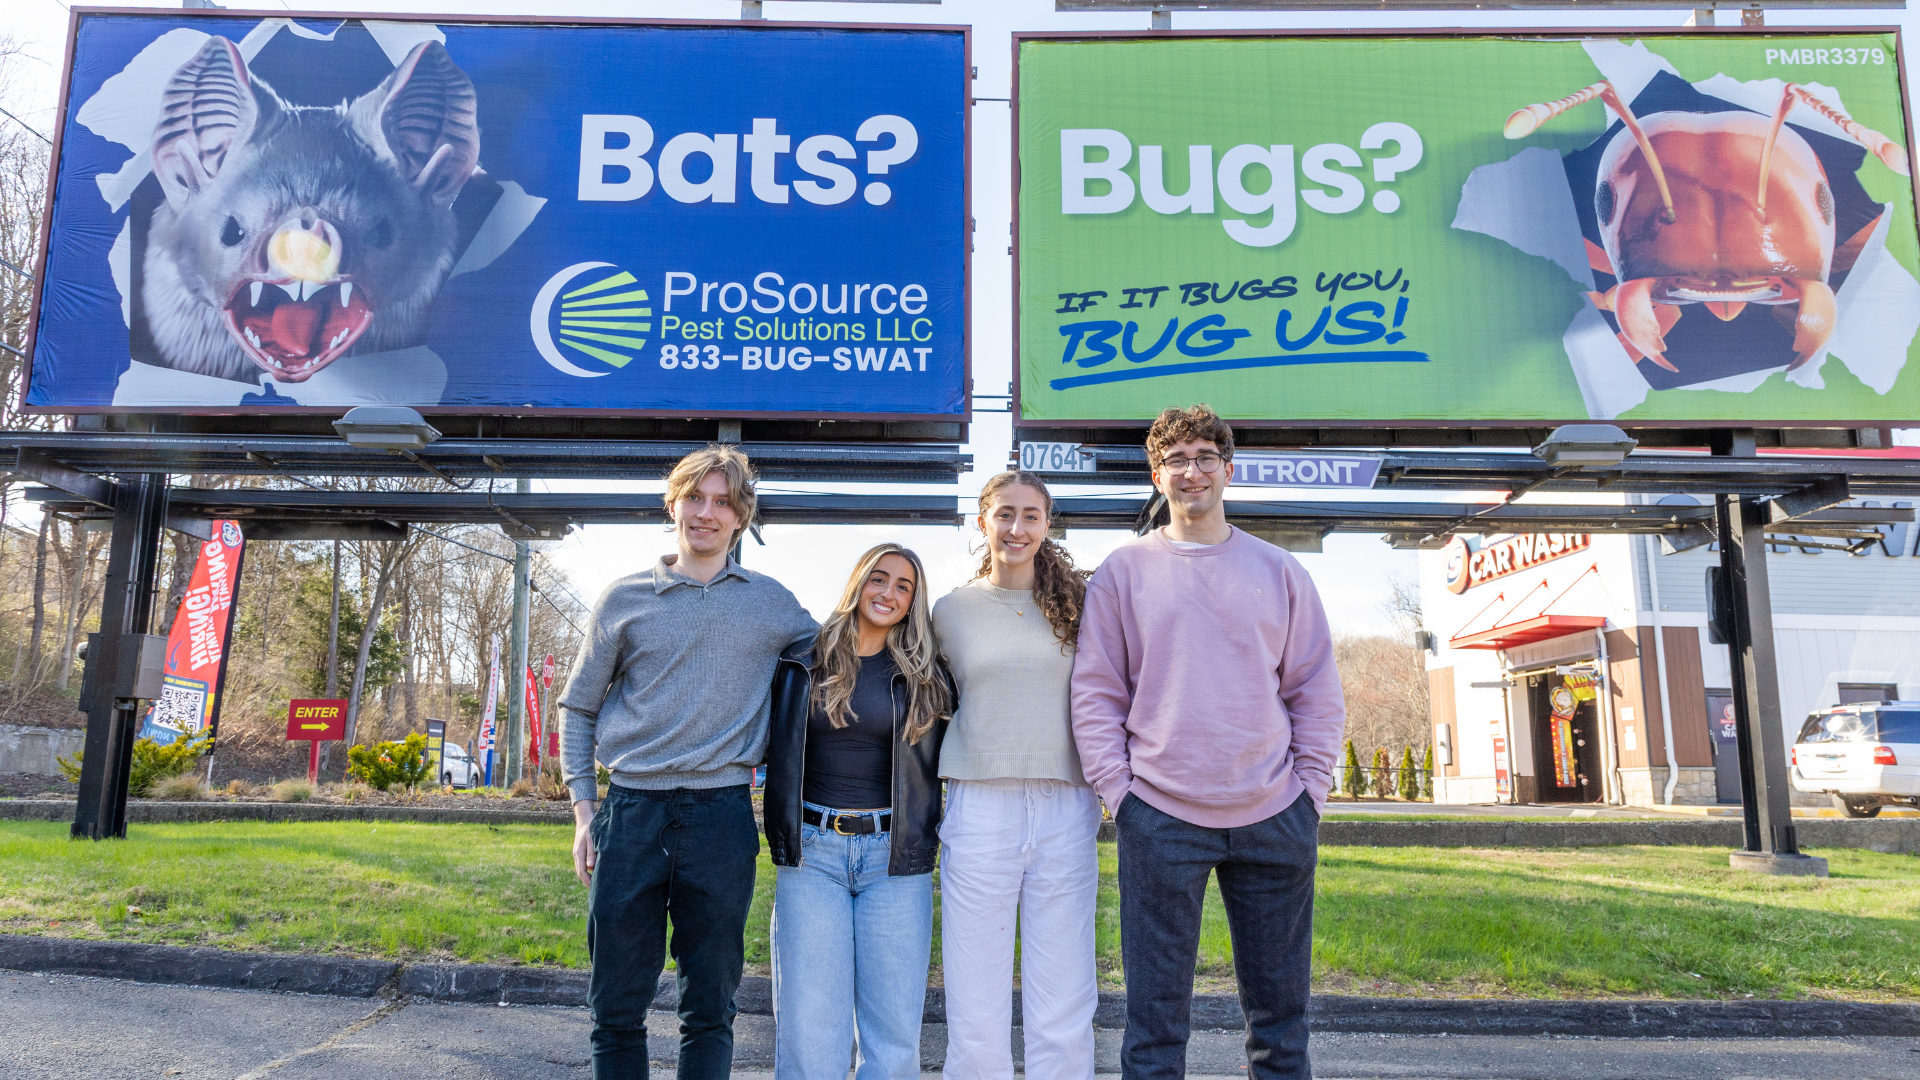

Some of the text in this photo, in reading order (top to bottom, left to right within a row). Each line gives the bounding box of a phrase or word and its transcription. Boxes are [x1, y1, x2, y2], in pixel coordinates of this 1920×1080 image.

[1765, 48, 1885, 65] PMBR3379
[577, 114, 919, 206] Bats?
[1060, 121, 1424, 248] Bugs?
[663, 271, 928, 315] ProSource
[1055, 268, 1410, 314] IF IT BUGS YOU,
[660, 316, 933, 342] Pest Solutions LLC
[1058, 296, 1409, 369] BUG US!
[659, 344, 933, 372] 833-BUG-SWAT
[1233, 459, 1360, 484] TFRONT
[1469, 544, 1512, 581] CAR
[543, 665, 555, 679] STOP
[295, 707, 339, 718] ENTER
[1721, 730, 1737, 738] WA
[1724, 723, 1737, 731] CA
